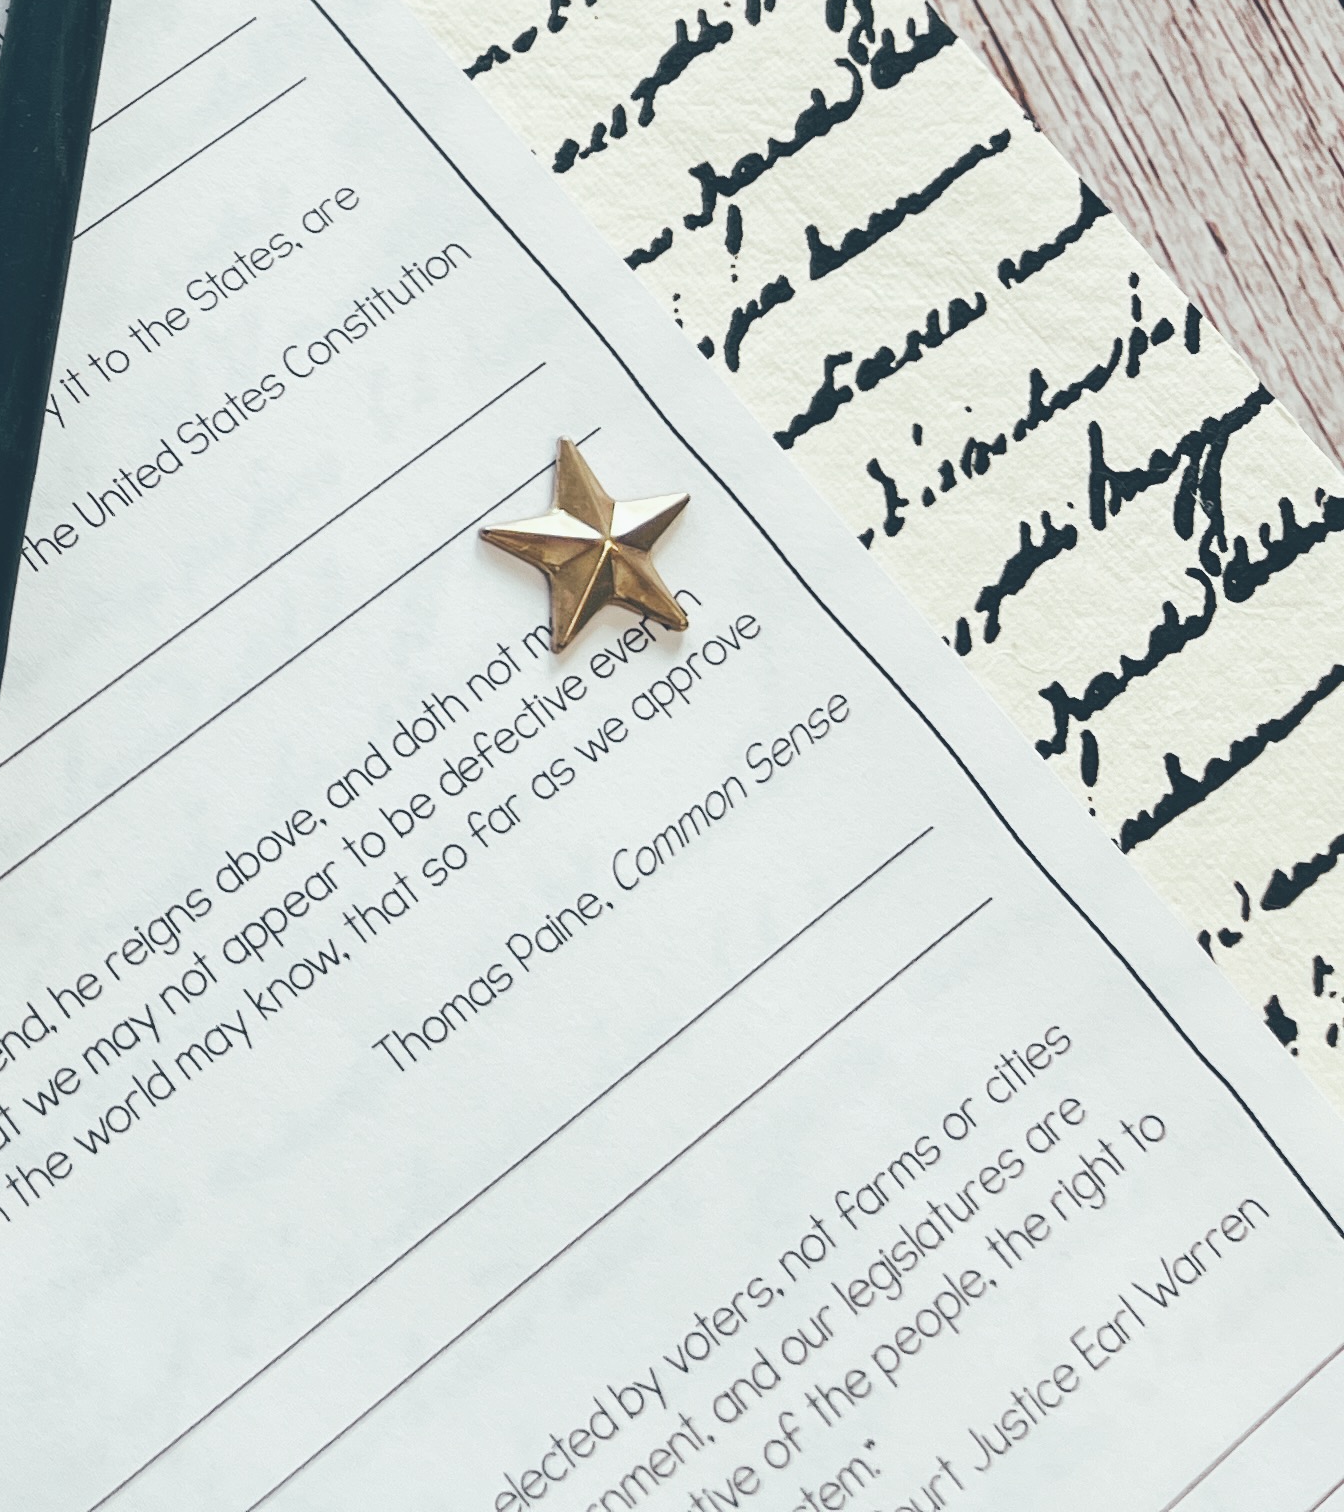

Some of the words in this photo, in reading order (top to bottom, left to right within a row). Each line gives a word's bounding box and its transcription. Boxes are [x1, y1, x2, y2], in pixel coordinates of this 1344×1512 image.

[71, 438, 185, 529] United
[175, 372, 287, 456] States
[281, 242, 473, 379] Constitution
[45, 972, 104, 1020] he
[102, 887, 214, 982] reigns
[215, 808, 329, 895] above,
[325, 740, 394, 810] and
[391, 691, 471, 759] doth
[464, 641, 522, 703] not
[370, 962, 515, 1073] Thomas
[503, 892, 615, 974] Paine,
[611, 775, 749, 892] Common
[744, 693, 851, 785] Sense
[606, 1366, 669, 1421] by
[662, 1276, 786, 1375] voters,
[777, 1213, 838, 1284] not
[833, 1134, 942, 1231] farms
[942, 1096, 978, 1142] or
[985, 1024, 1073, 1105] cities
[967, 1363, 1081, 1473] Justice
[1068, 1293, 1147, 1372] Earl
[1130, 1198, 1271, 1309] Warren
